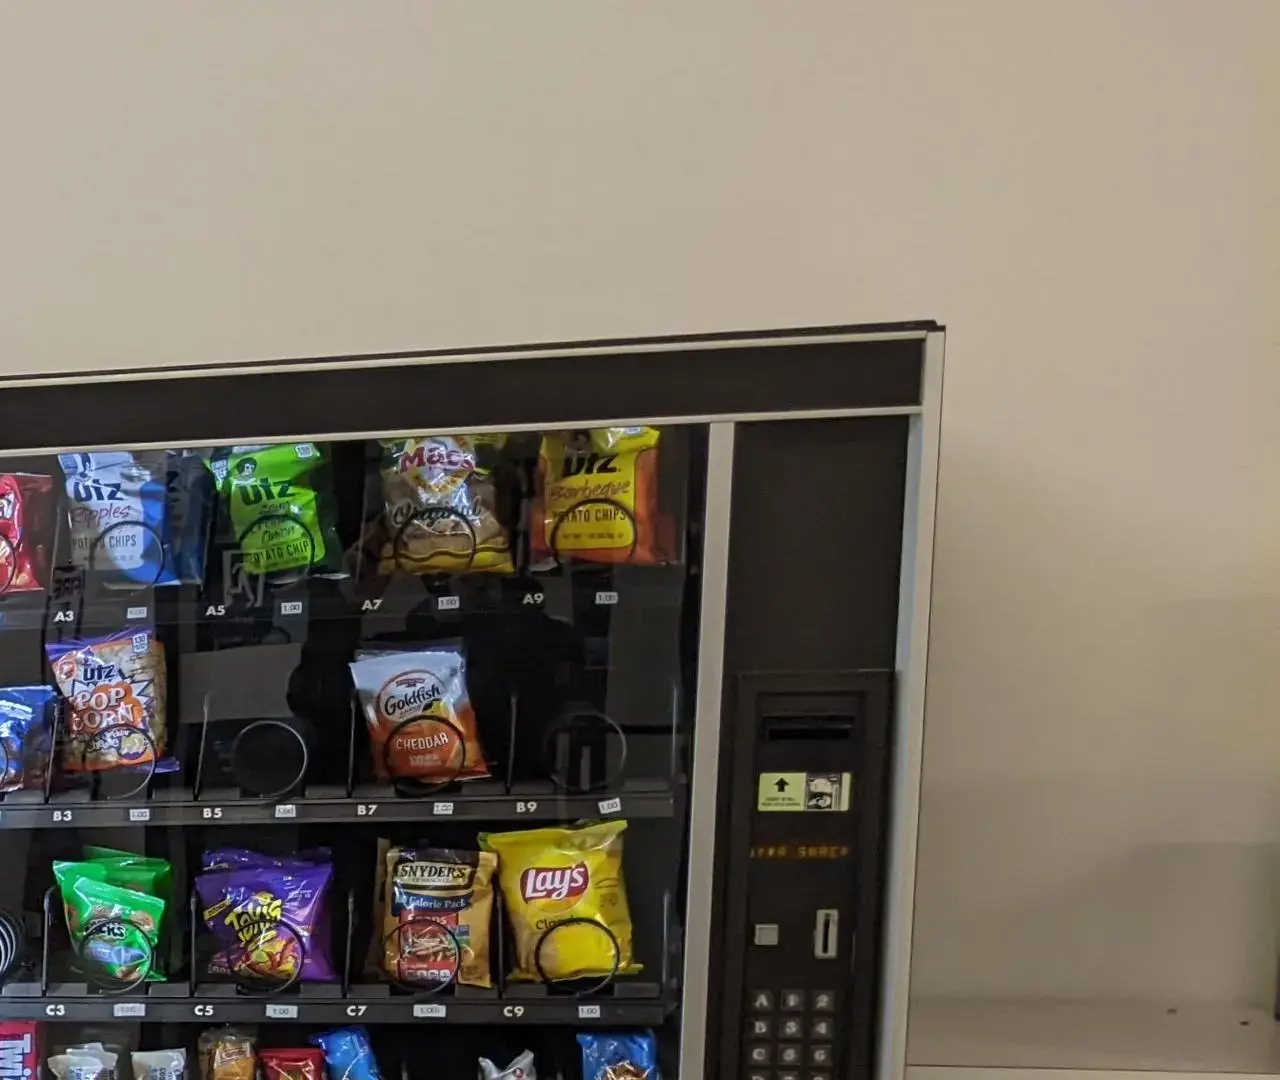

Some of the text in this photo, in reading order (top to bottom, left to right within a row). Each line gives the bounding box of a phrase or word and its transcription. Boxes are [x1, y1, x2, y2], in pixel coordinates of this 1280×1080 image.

[595, 508, 627, 522] CHIPS
[109, 534, 137, 548] CHIPS
[287, 540, 310, 556] CHIP
[523, 593, 543, 604] A9
[206, 605, 225, 615] A5
[362, 600, 382, 610] A7
[54, 611, 73, 621] A3
[77, 687, 125, 711] POP
[384, 684, 441, 717] Goldfish
[396, 732, 449, 751] CHEDDAR
[358, 805, 377, 815] B7
[517, 802, 536, 812] B9
[53, 811, 71, 821] B3
[204, 808, 222, 818] B5
[524, 860, 586, 901] Lay's
[46, 1005, 64, 1015] C3
[195, 1005, 213, 1015] C5
[347, 1006, 366, 1016] C7
[504, 1006, 524, 1016] C9
